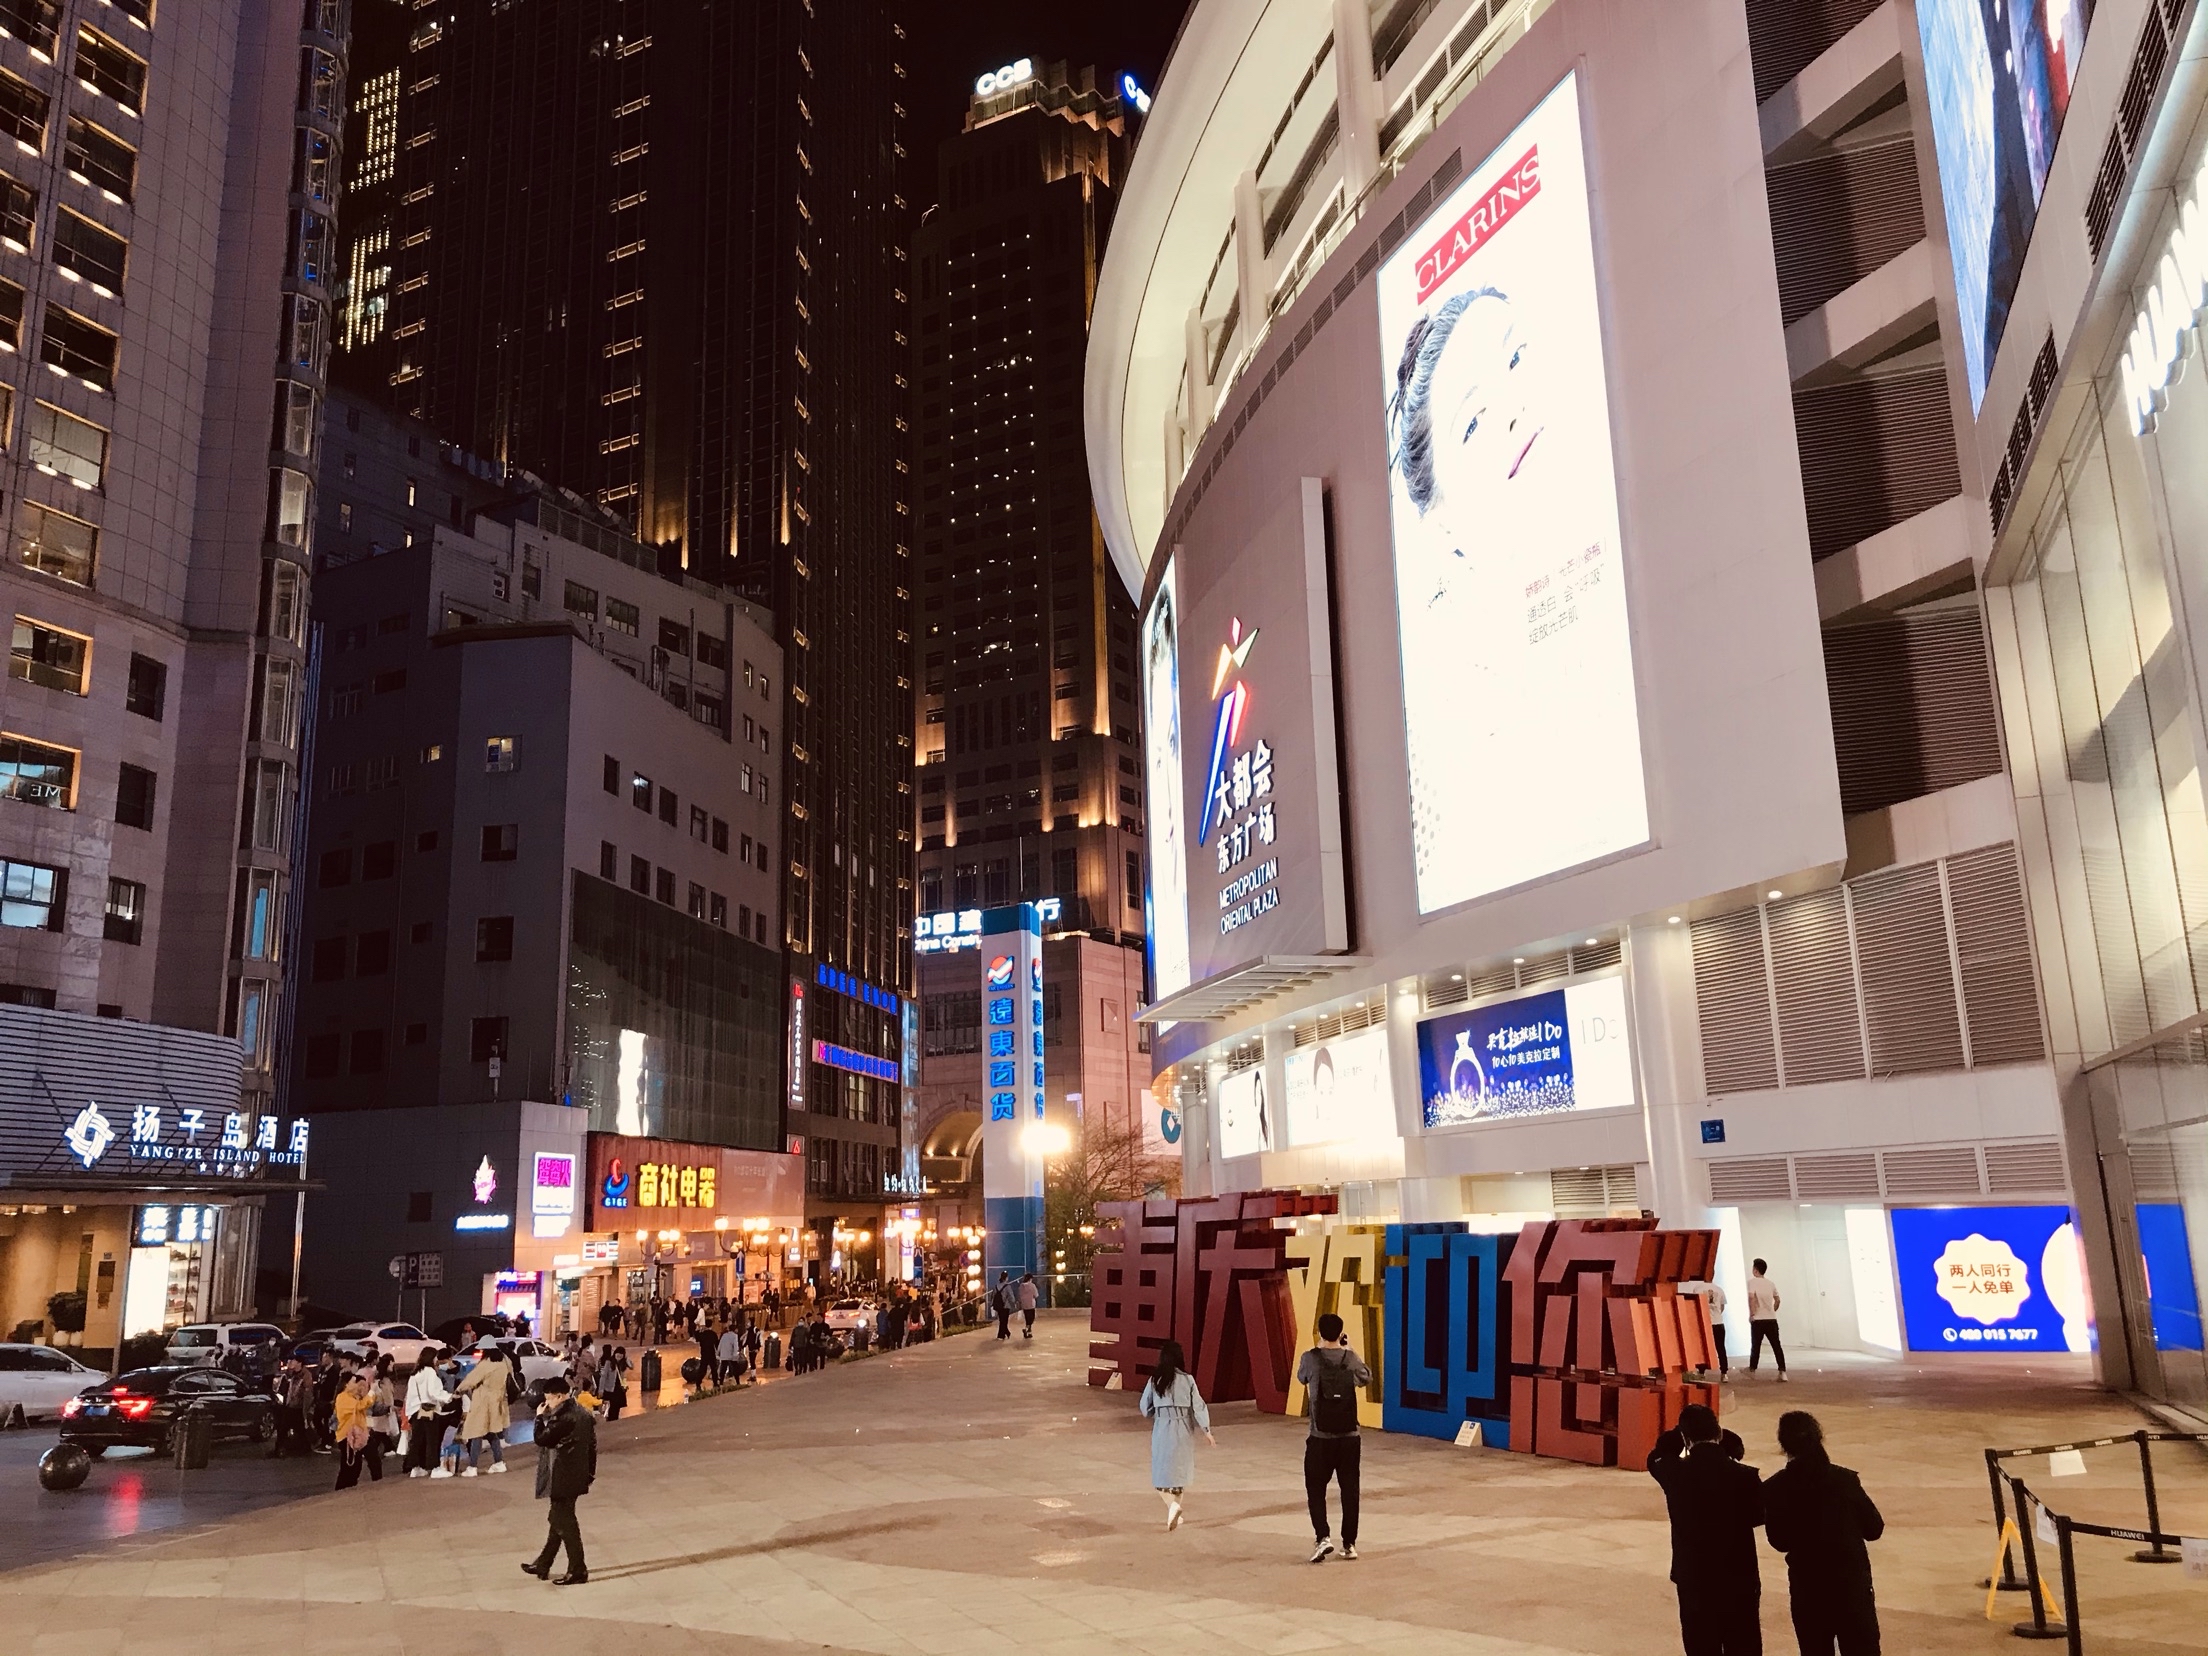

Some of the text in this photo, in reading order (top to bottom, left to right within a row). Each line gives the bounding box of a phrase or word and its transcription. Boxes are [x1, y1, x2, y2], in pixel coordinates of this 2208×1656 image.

[976, 57, 1033, 96] CCB
[1416, 155, 1541, 293] CLARINS
[1215, 739, 1274, 828] 大都会
[1217, 802, 1276, 874] 东方广场
[1219, 857, 1279, 910] METROPOLITAN
[1220, 888, 1280, 935] ORIENTAL PLAZA
[989, 997, 1016, 1122] 遠東百货
[131, 1104, 310, 1152] 扬子岛酒店
[130, 1144, 305, 1164] YANGTZE ISLAND HOTEL
[638, 1162, 716, 1208] 商社电器
[1949, 1263, 2011, 1278] 两人同行
[1952, 1280, 2015, 1294] 一人免单
[2110, 1529, 2145, 1541] HUAWEI
